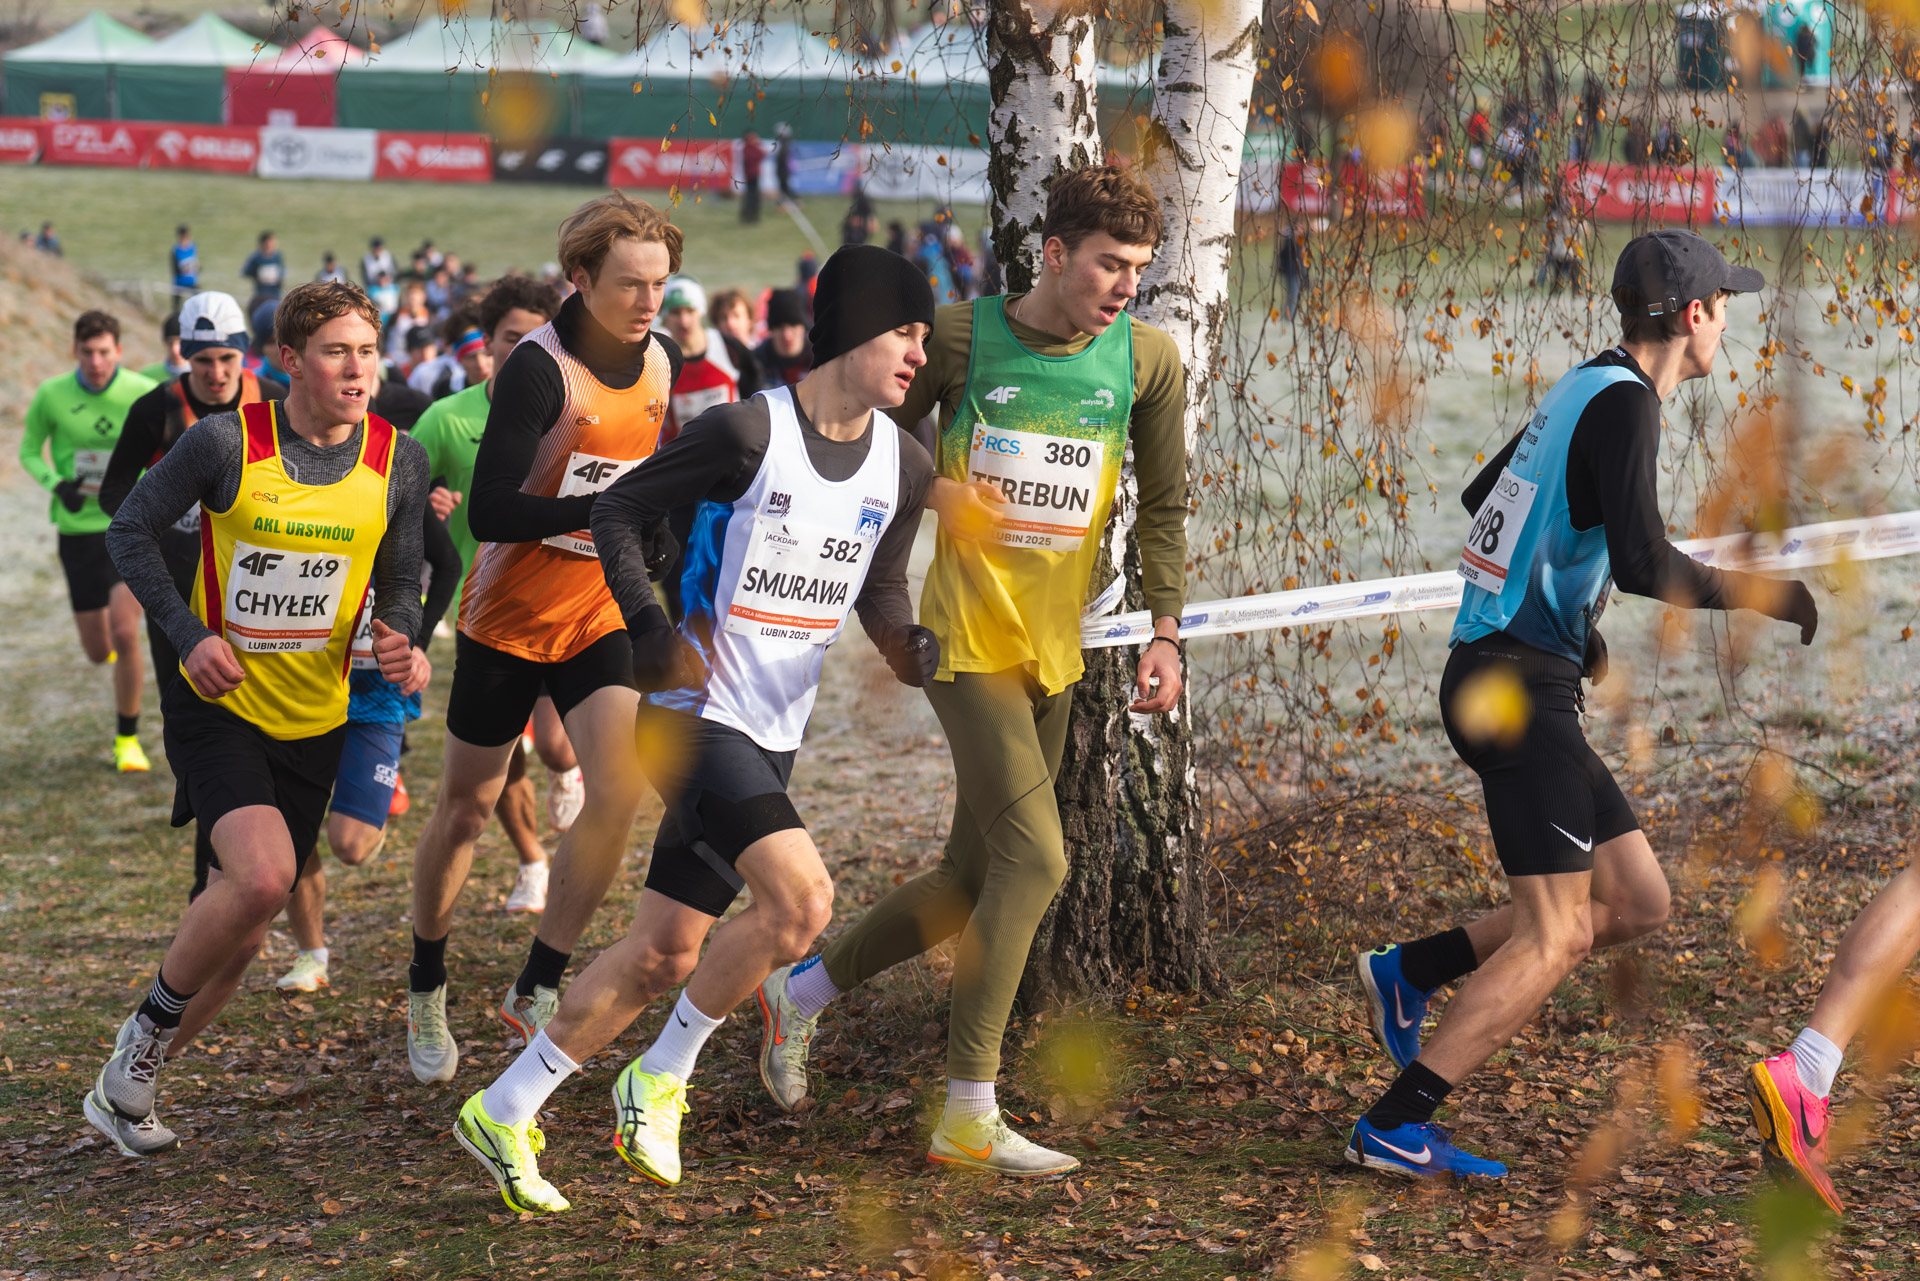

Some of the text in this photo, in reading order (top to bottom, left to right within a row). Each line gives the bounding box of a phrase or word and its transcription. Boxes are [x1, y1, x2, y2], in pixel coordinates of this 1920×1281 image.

[0, 128, 37, 149] RLEN
[190, 136, 255, 160] ORLEN
[417, 145, 486, 168] ORLEN
[985, 386, 1021, 404] 4F
[576, 415, 600, 426] esa
[1044, 442, 1091, 467] 380
[573, 460, 619, 484] 4F
[251, 491, 279, 504] esa
[769, 491, 792, 509] BCM
[862, 496, 889, 509] JUVENIA
[254, 516, 355, 542] AKL URSYNÓW
[992, 529, 1052, 546] LUBIN 2025
[1468, 503, 1504, 555] 698
[574, 542, 599, 553] LUBI
[819, 537, 862, 563] 582
[239, 551, 284, 577] 4F
[299, 559, 339, 577] 169
[1464, 566, 1479, 580] 2025
[742, 566, 849, 606] SMURAWA
[235, 589, 329, 617] CHYŁEK
[760, 627, 811, 640] LUBIN 2025
[248, 642, 302, 650] LUBIN 2025
